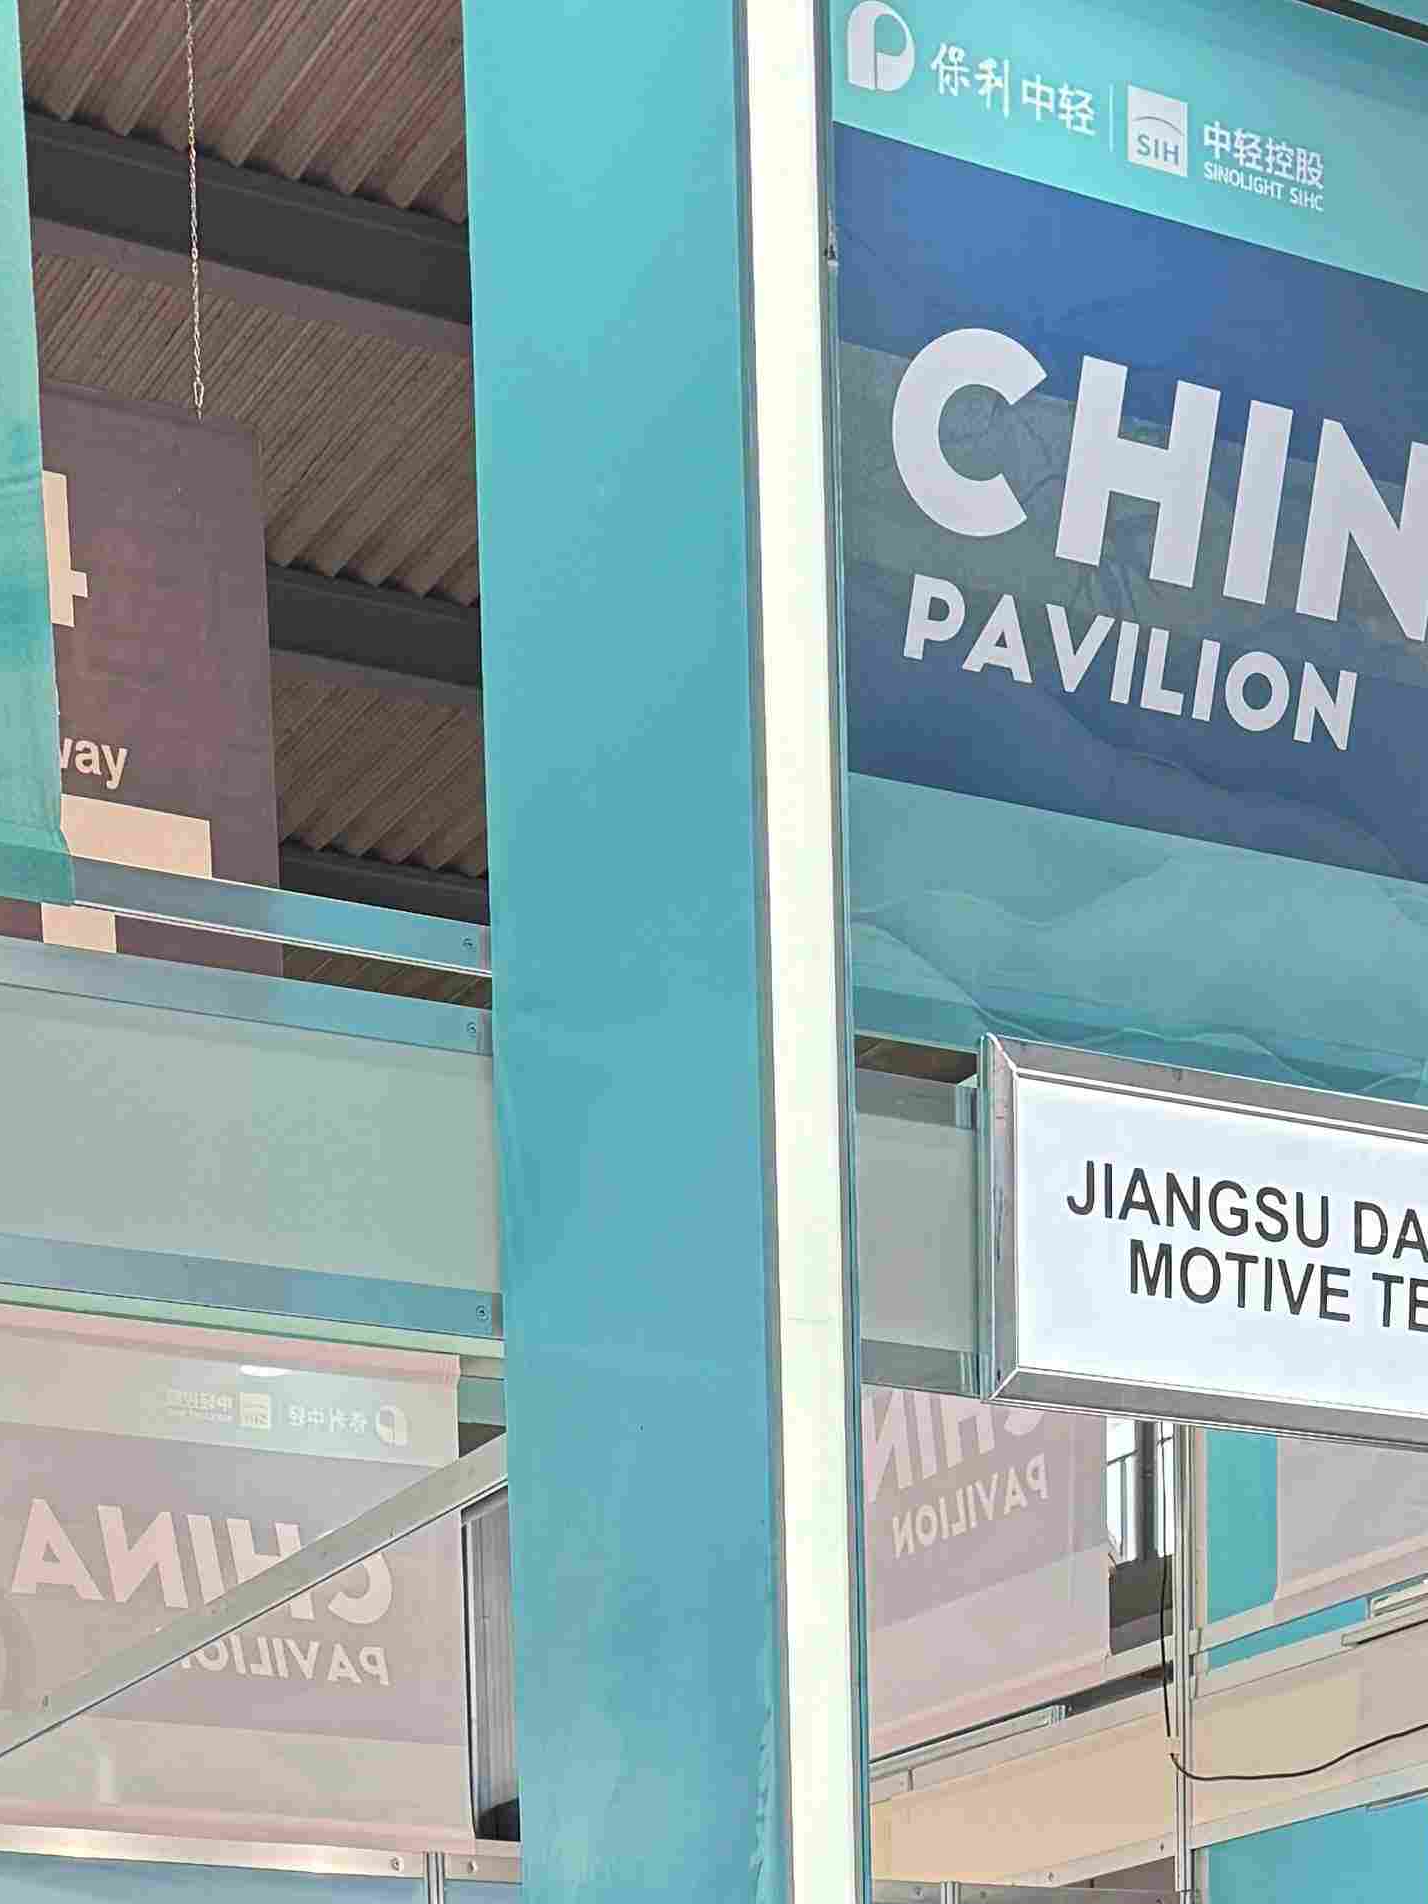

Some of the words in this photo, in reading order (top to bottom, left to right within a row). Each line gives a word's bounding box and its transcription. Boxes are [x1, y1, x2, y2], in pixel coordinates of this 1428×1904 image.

[930, 41, 1097, 137] 保利中轻
[1136, 132, 1180, 168] SIH
[1204, 121, 1324, 188] 中轻控股
[1204, 160, 1284, 201] SINOLIGHT
[903, 573, 1358, 751] PAVILION
[1066, 1160, 1329, 1249] JIANGSU
[1129, 1239, 1350, 1324] MOTIVE
